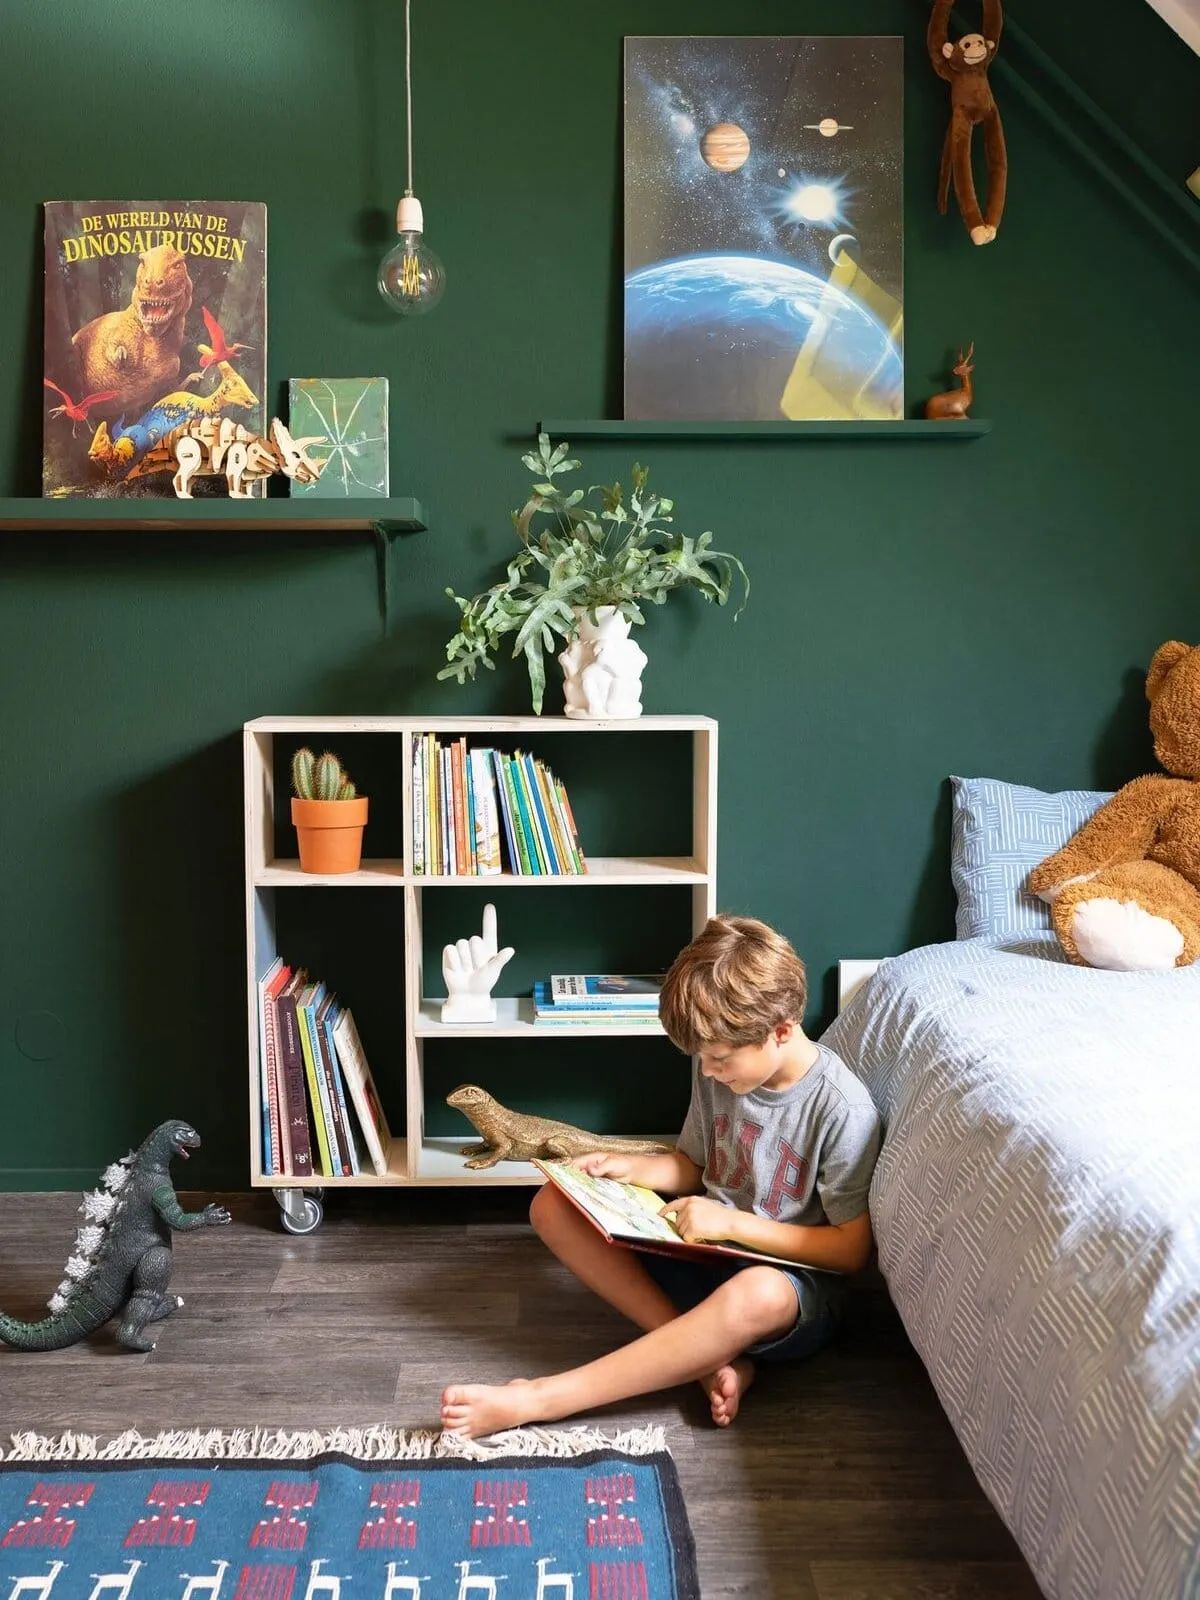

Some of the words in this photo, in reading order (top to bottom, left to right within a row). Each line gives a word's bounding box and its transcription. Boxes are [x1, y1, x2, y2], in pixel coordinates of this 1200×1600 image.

[81, 215, 103, 233] DE
[105, 211, 170, 229] WERELD
[173, 212, 203, 229] VAN
[206, 215, 228, 233] DE
[62, 230, 247, 263] DINOSAURUSSEN
